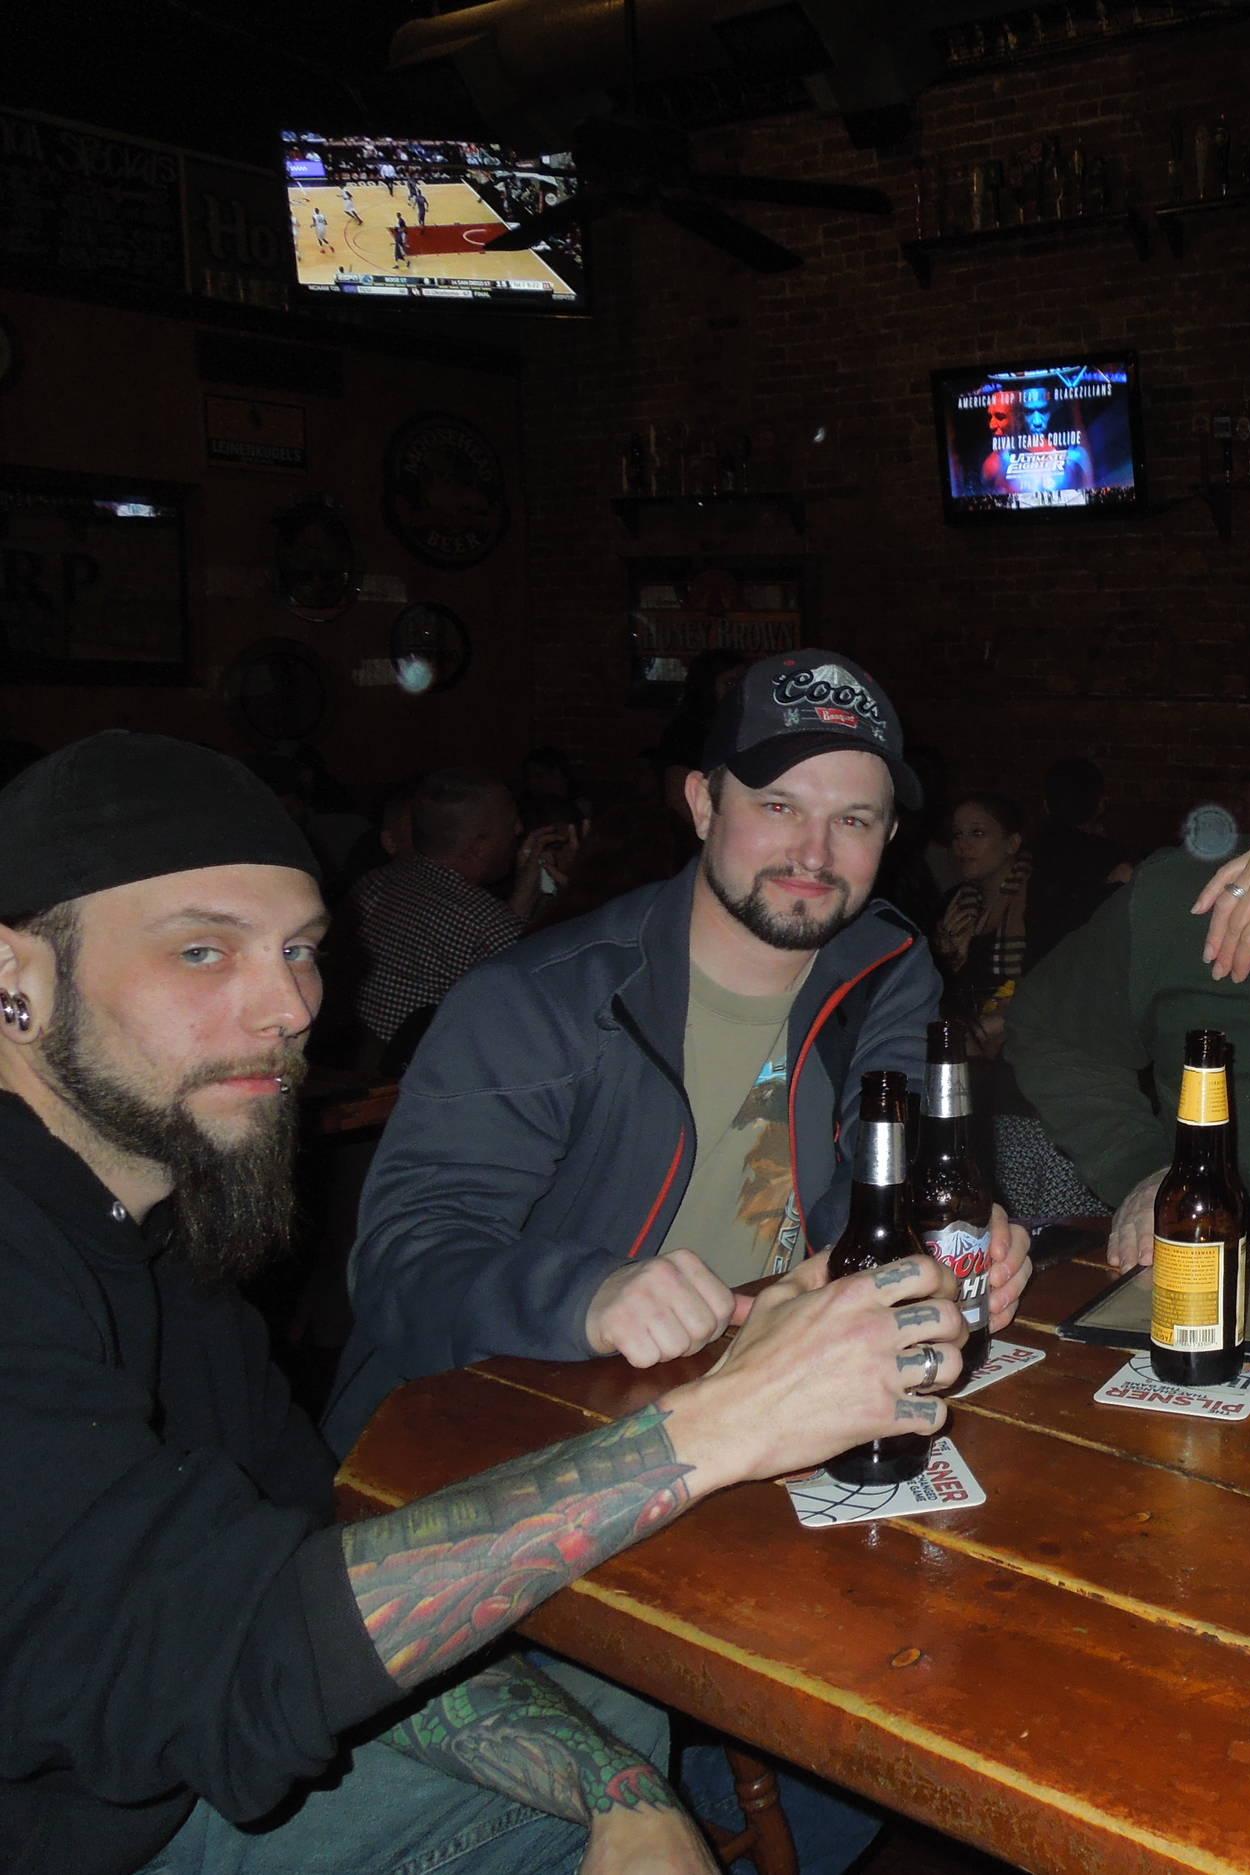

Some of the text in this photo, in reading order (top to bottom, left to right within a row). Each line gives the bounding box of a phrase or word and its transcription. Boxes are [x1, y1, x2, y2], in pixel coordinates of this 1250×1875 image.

[958, 395, 996, 409] AMERICAN
[1054, 384, 1112, 400] BLACKZILIANS
[992, 431, 1081, 450] RIVAL TEAMS COLLIDE
[772, 669, 887, 729] Coors
[1105, 1386, 1245, 1413] PILSNER
